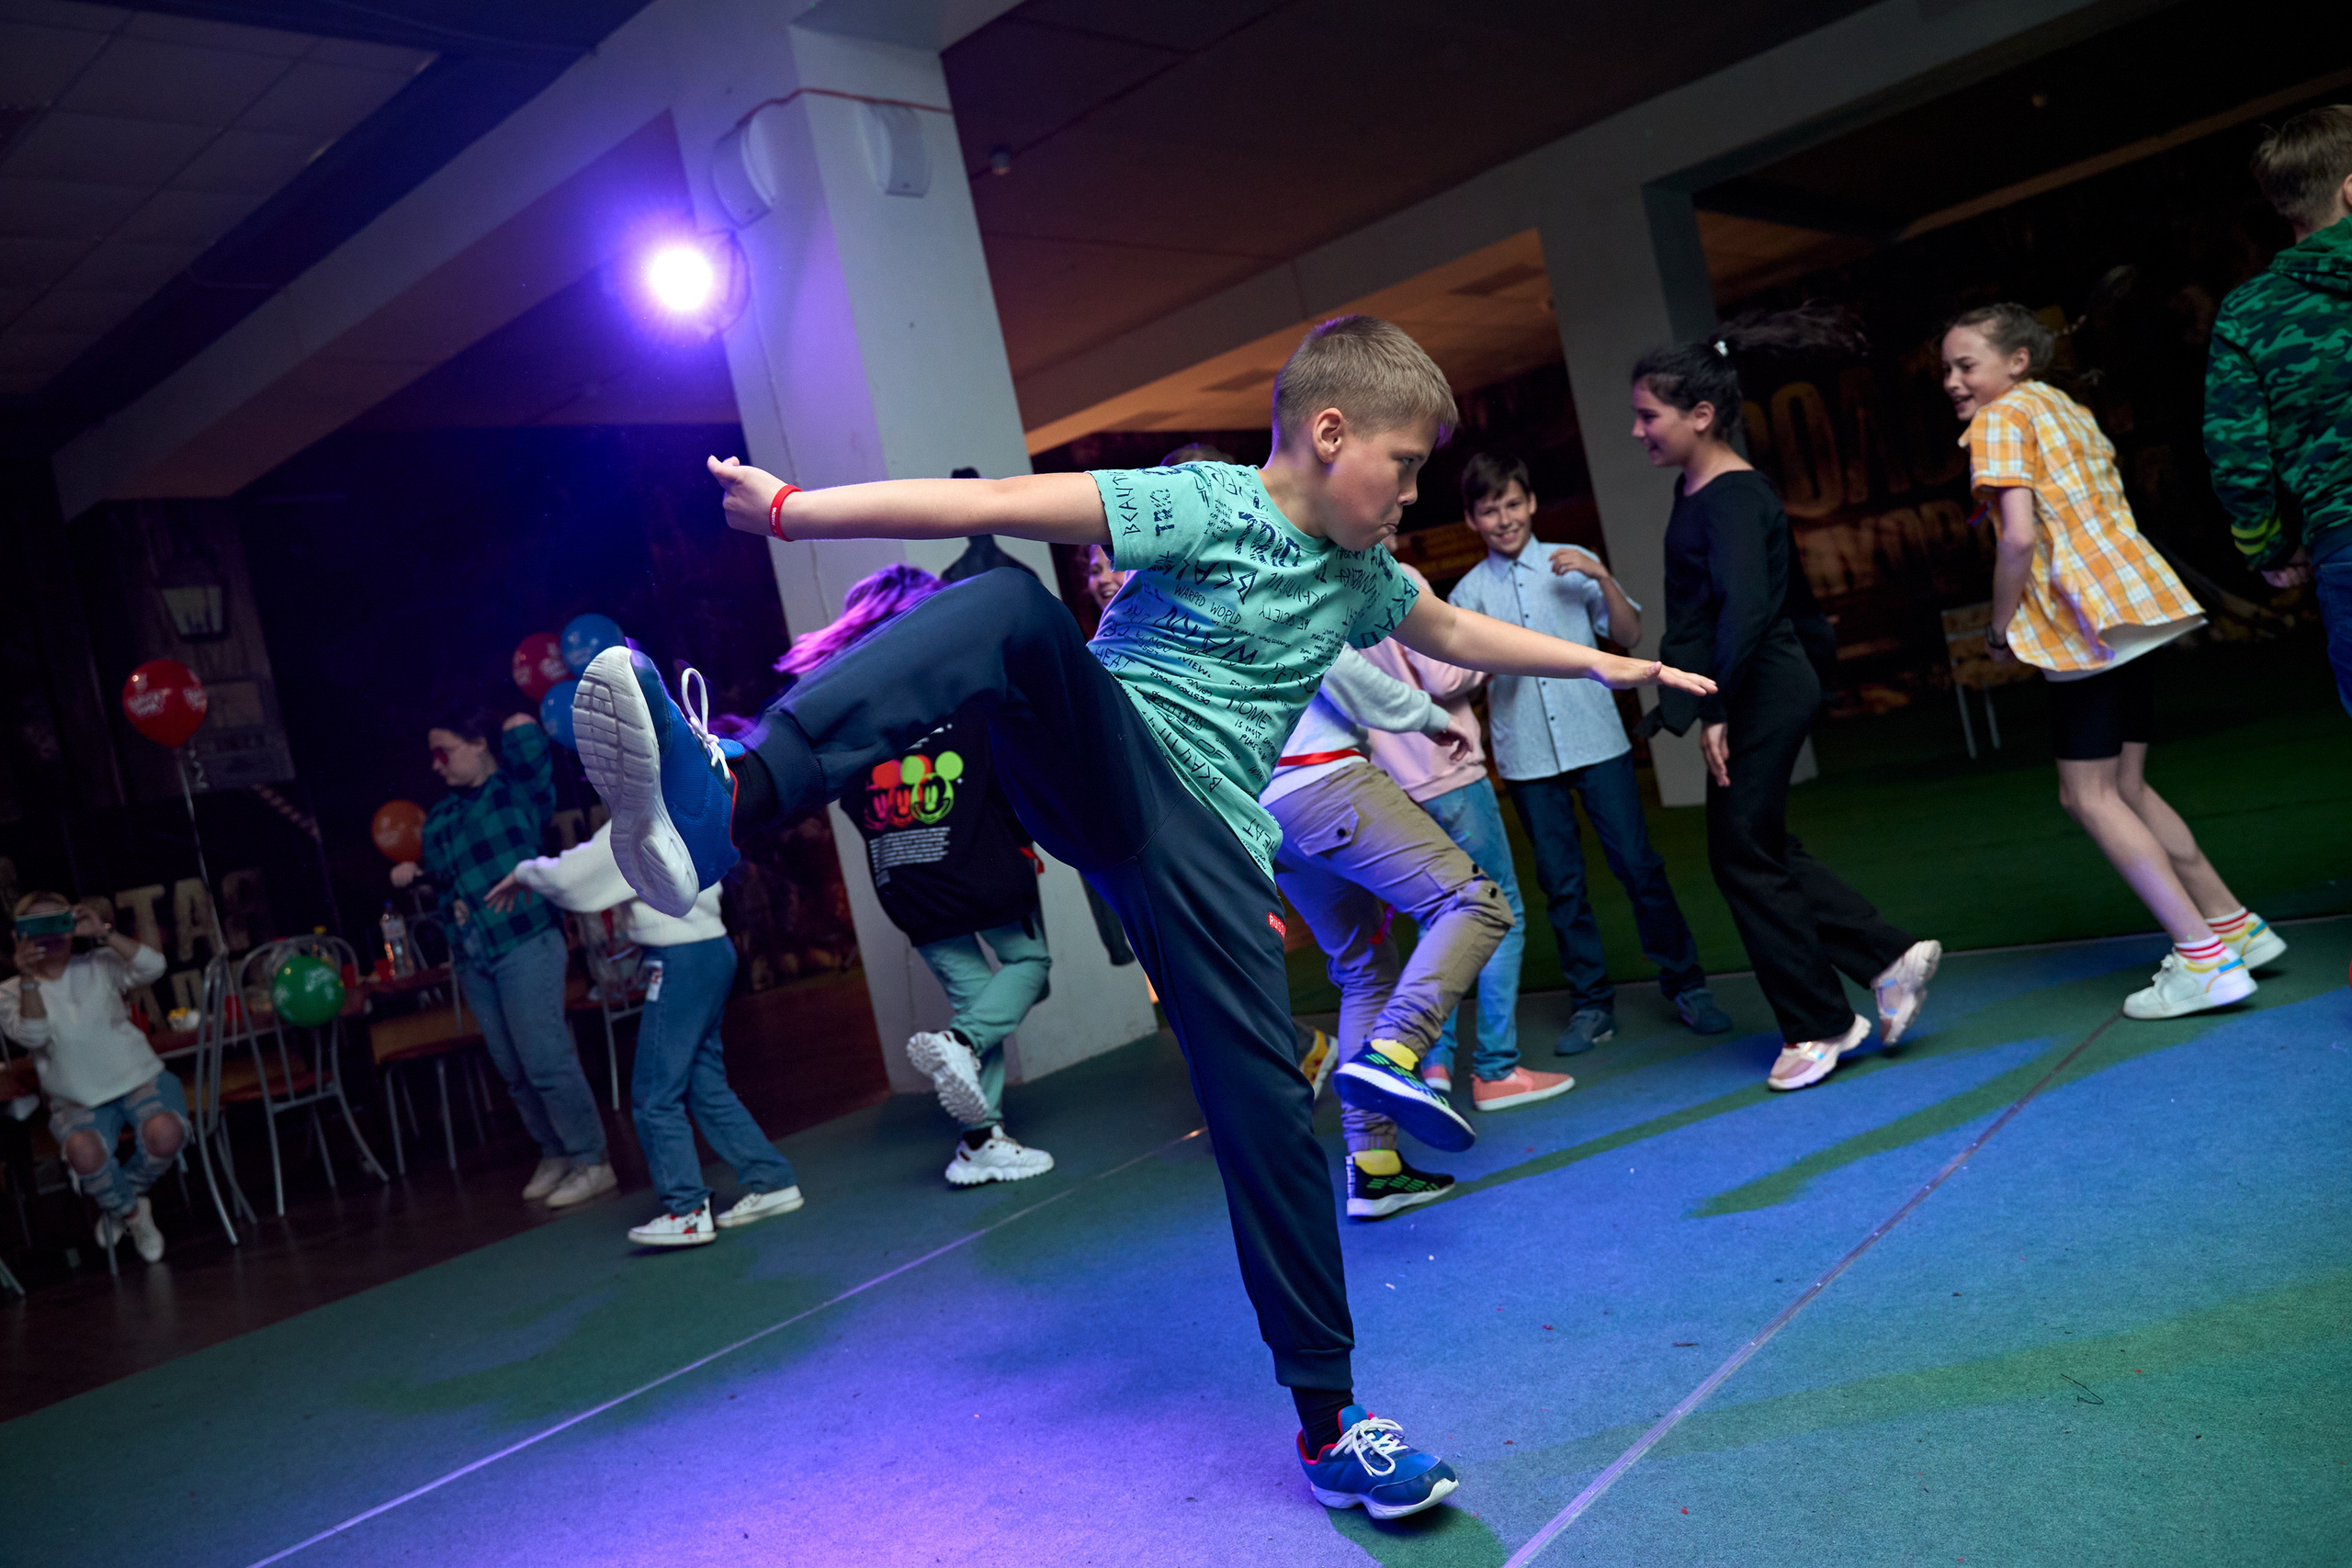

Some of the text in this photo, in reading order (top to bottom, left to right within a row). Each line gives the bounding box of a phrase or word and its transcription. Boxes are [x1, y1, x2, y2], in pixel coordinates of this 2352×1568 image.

[1174, 583, 1206, 607] WARPED
[1210, 602, 1242, 625] WORLD
[1150, 671, 1173, 686] POWER
[1175, 683, 1211, 705] DESTROY
[1196, 739, 1231, 760] OF
